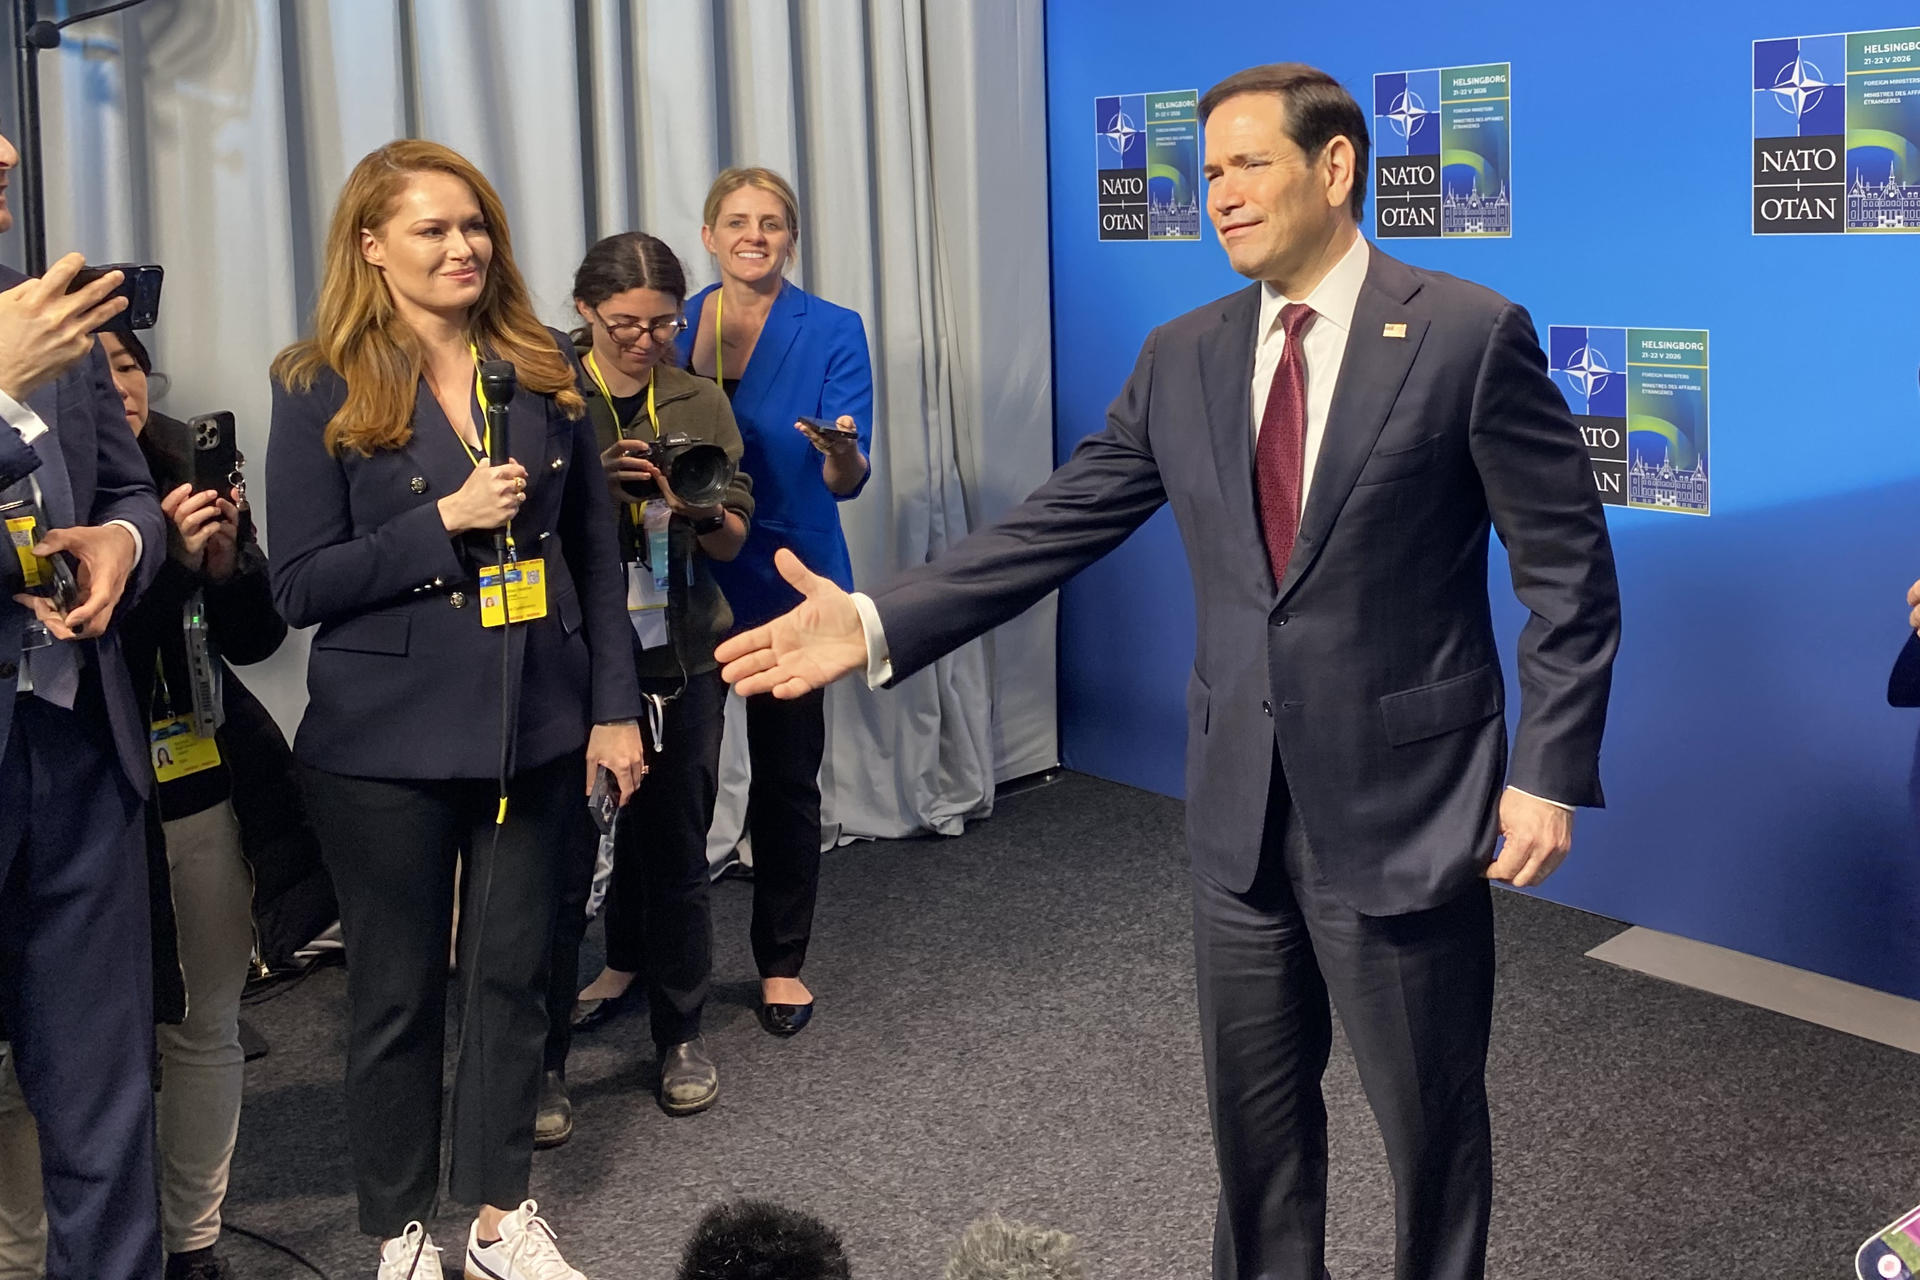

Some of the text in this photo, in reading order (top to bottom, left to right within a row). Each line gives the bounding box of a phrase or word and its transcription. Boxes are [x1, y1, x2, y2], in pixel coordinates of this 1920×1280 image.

[1863, 41, 1920, 54] HELSINGBO
[1863, 57, 1884, 65] 21-22
[1892, 55, 1911, 63] 2026
[1453, 75, 1506, 86] HELSINGBORG
[1761, 148, 1836, 172] NATO
[1381, 165, 1435, 186] NATO
[1102, 178, 1143, 195] NATO
[1381, 207, 1436, 226] OTAN
[1760, 198, 1837, 221] OTAN
[1102, 213, 1144, 231] OTAN
[1641, 340, 1704, 351] HELSINGBORG
